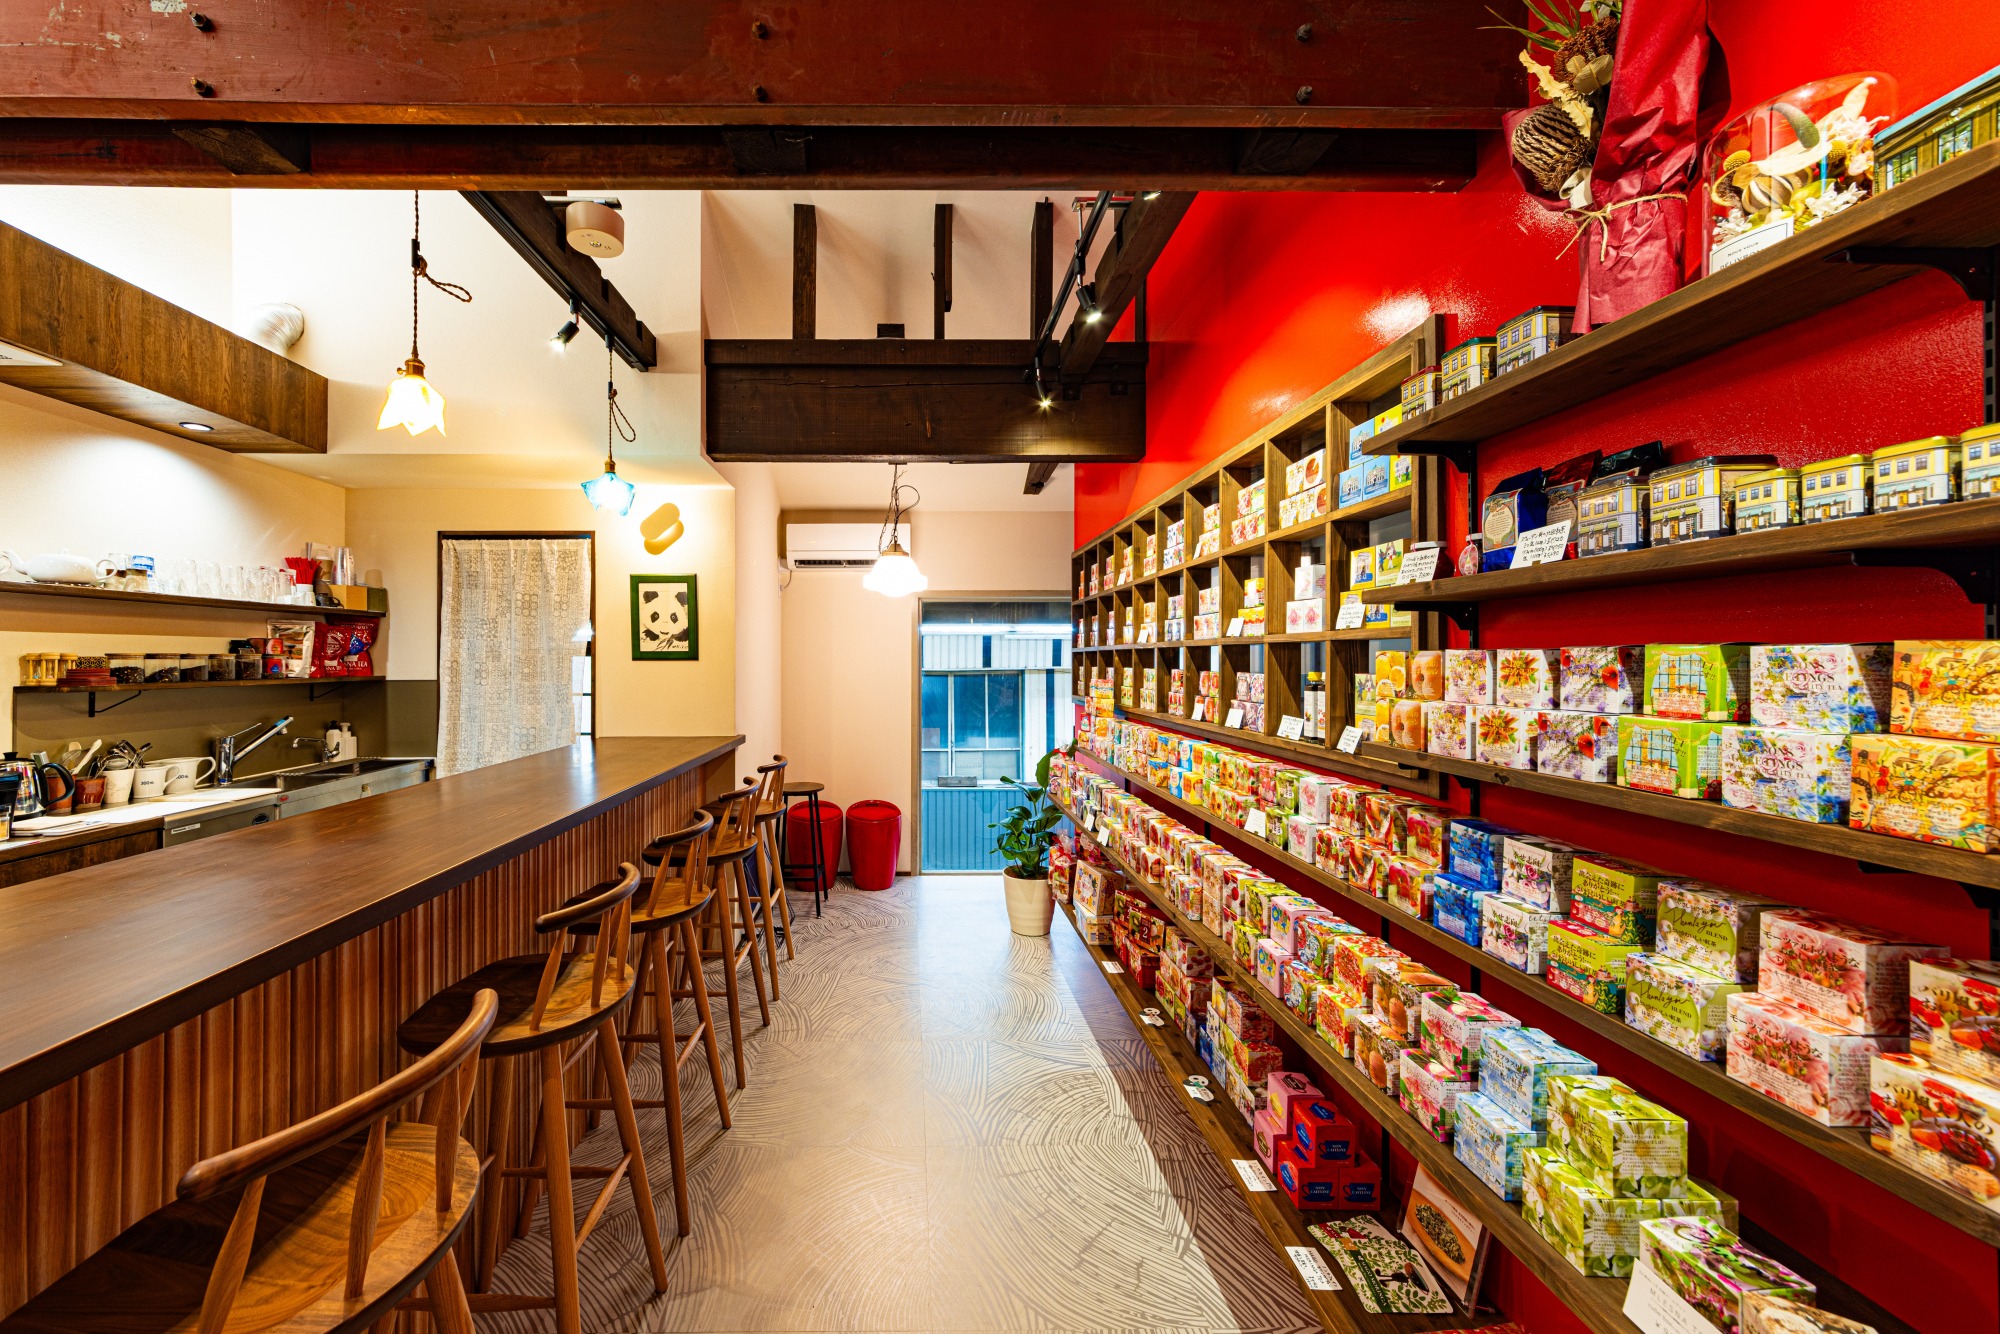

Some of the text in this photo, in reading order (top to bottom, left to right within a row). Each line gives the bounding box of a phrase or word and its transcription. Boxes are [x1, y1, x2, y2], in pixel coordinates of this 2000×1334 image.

[1578, 869, 1625, 891] 出会えた奇跡に
[1142, 926, 1148, 939] 2
[1705, 929, 1728, 942] BLEND
[1553, 935, 1596, 960] 出会えた奇跡に
[1763, 930, 1860, 969] モーツァルトのような
[1671, 1005, 1692, 1019] BLEND
[1730, 1013, 1824, 1060] モーツァルトのような
[1371, 1277, 1387, 1306] MORINGA
[1650, 1287, 1688, 1325] MLESNA
